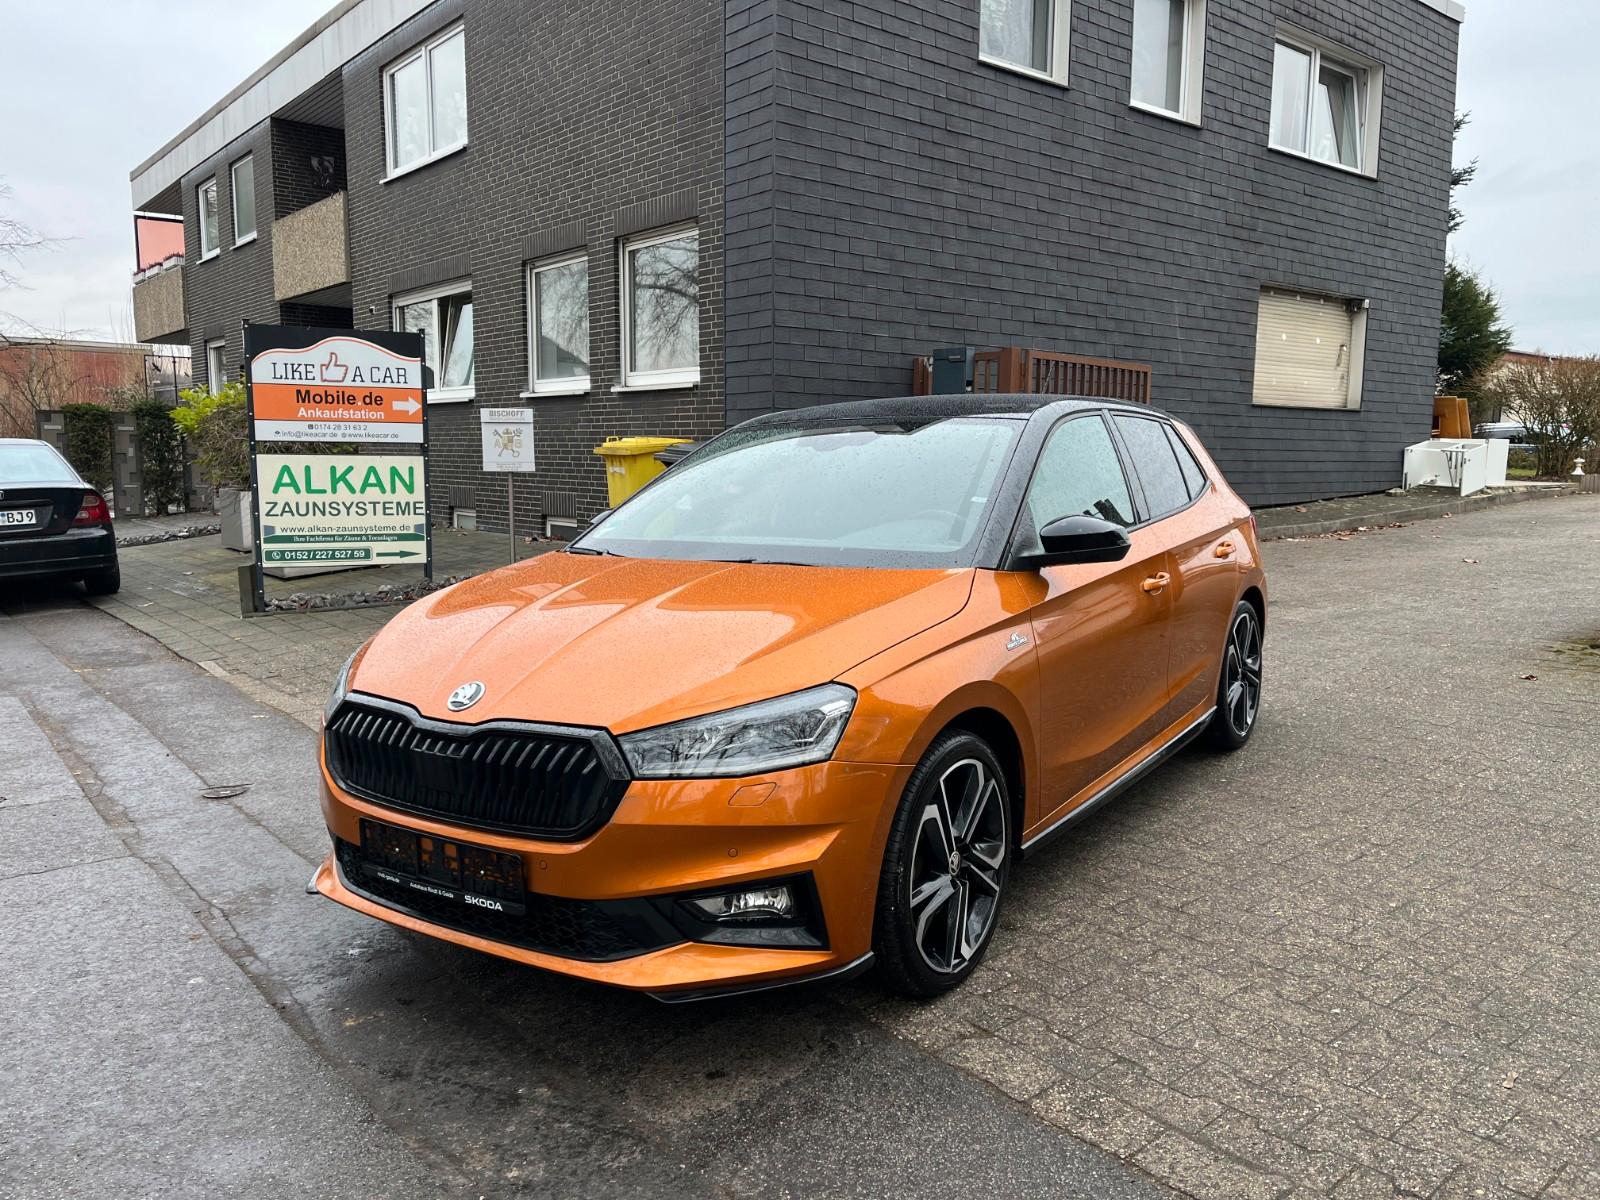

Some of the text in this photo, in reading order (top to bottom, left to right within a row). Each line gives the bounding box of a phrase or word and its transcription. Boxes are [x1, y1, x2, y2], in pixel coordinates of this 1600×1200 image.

[272, 363, 408, 384] LIKE A CAR
[296, 389, 384, 406] Mobile.de
[297, 407, 385, 419] Ankaufstation
[272, 464, 414, 495] ALKAN
[265, 501, 425, 517] ZAUNSYSTEME
[280, 525, 411, 535] www.alkan-zaunsysteme.de
[284, 551, 309, 560] 0152
[315, 551, 332, 559] 227
[334, 550, 351, 559] 527
[353, 550, 365, 558] 59
